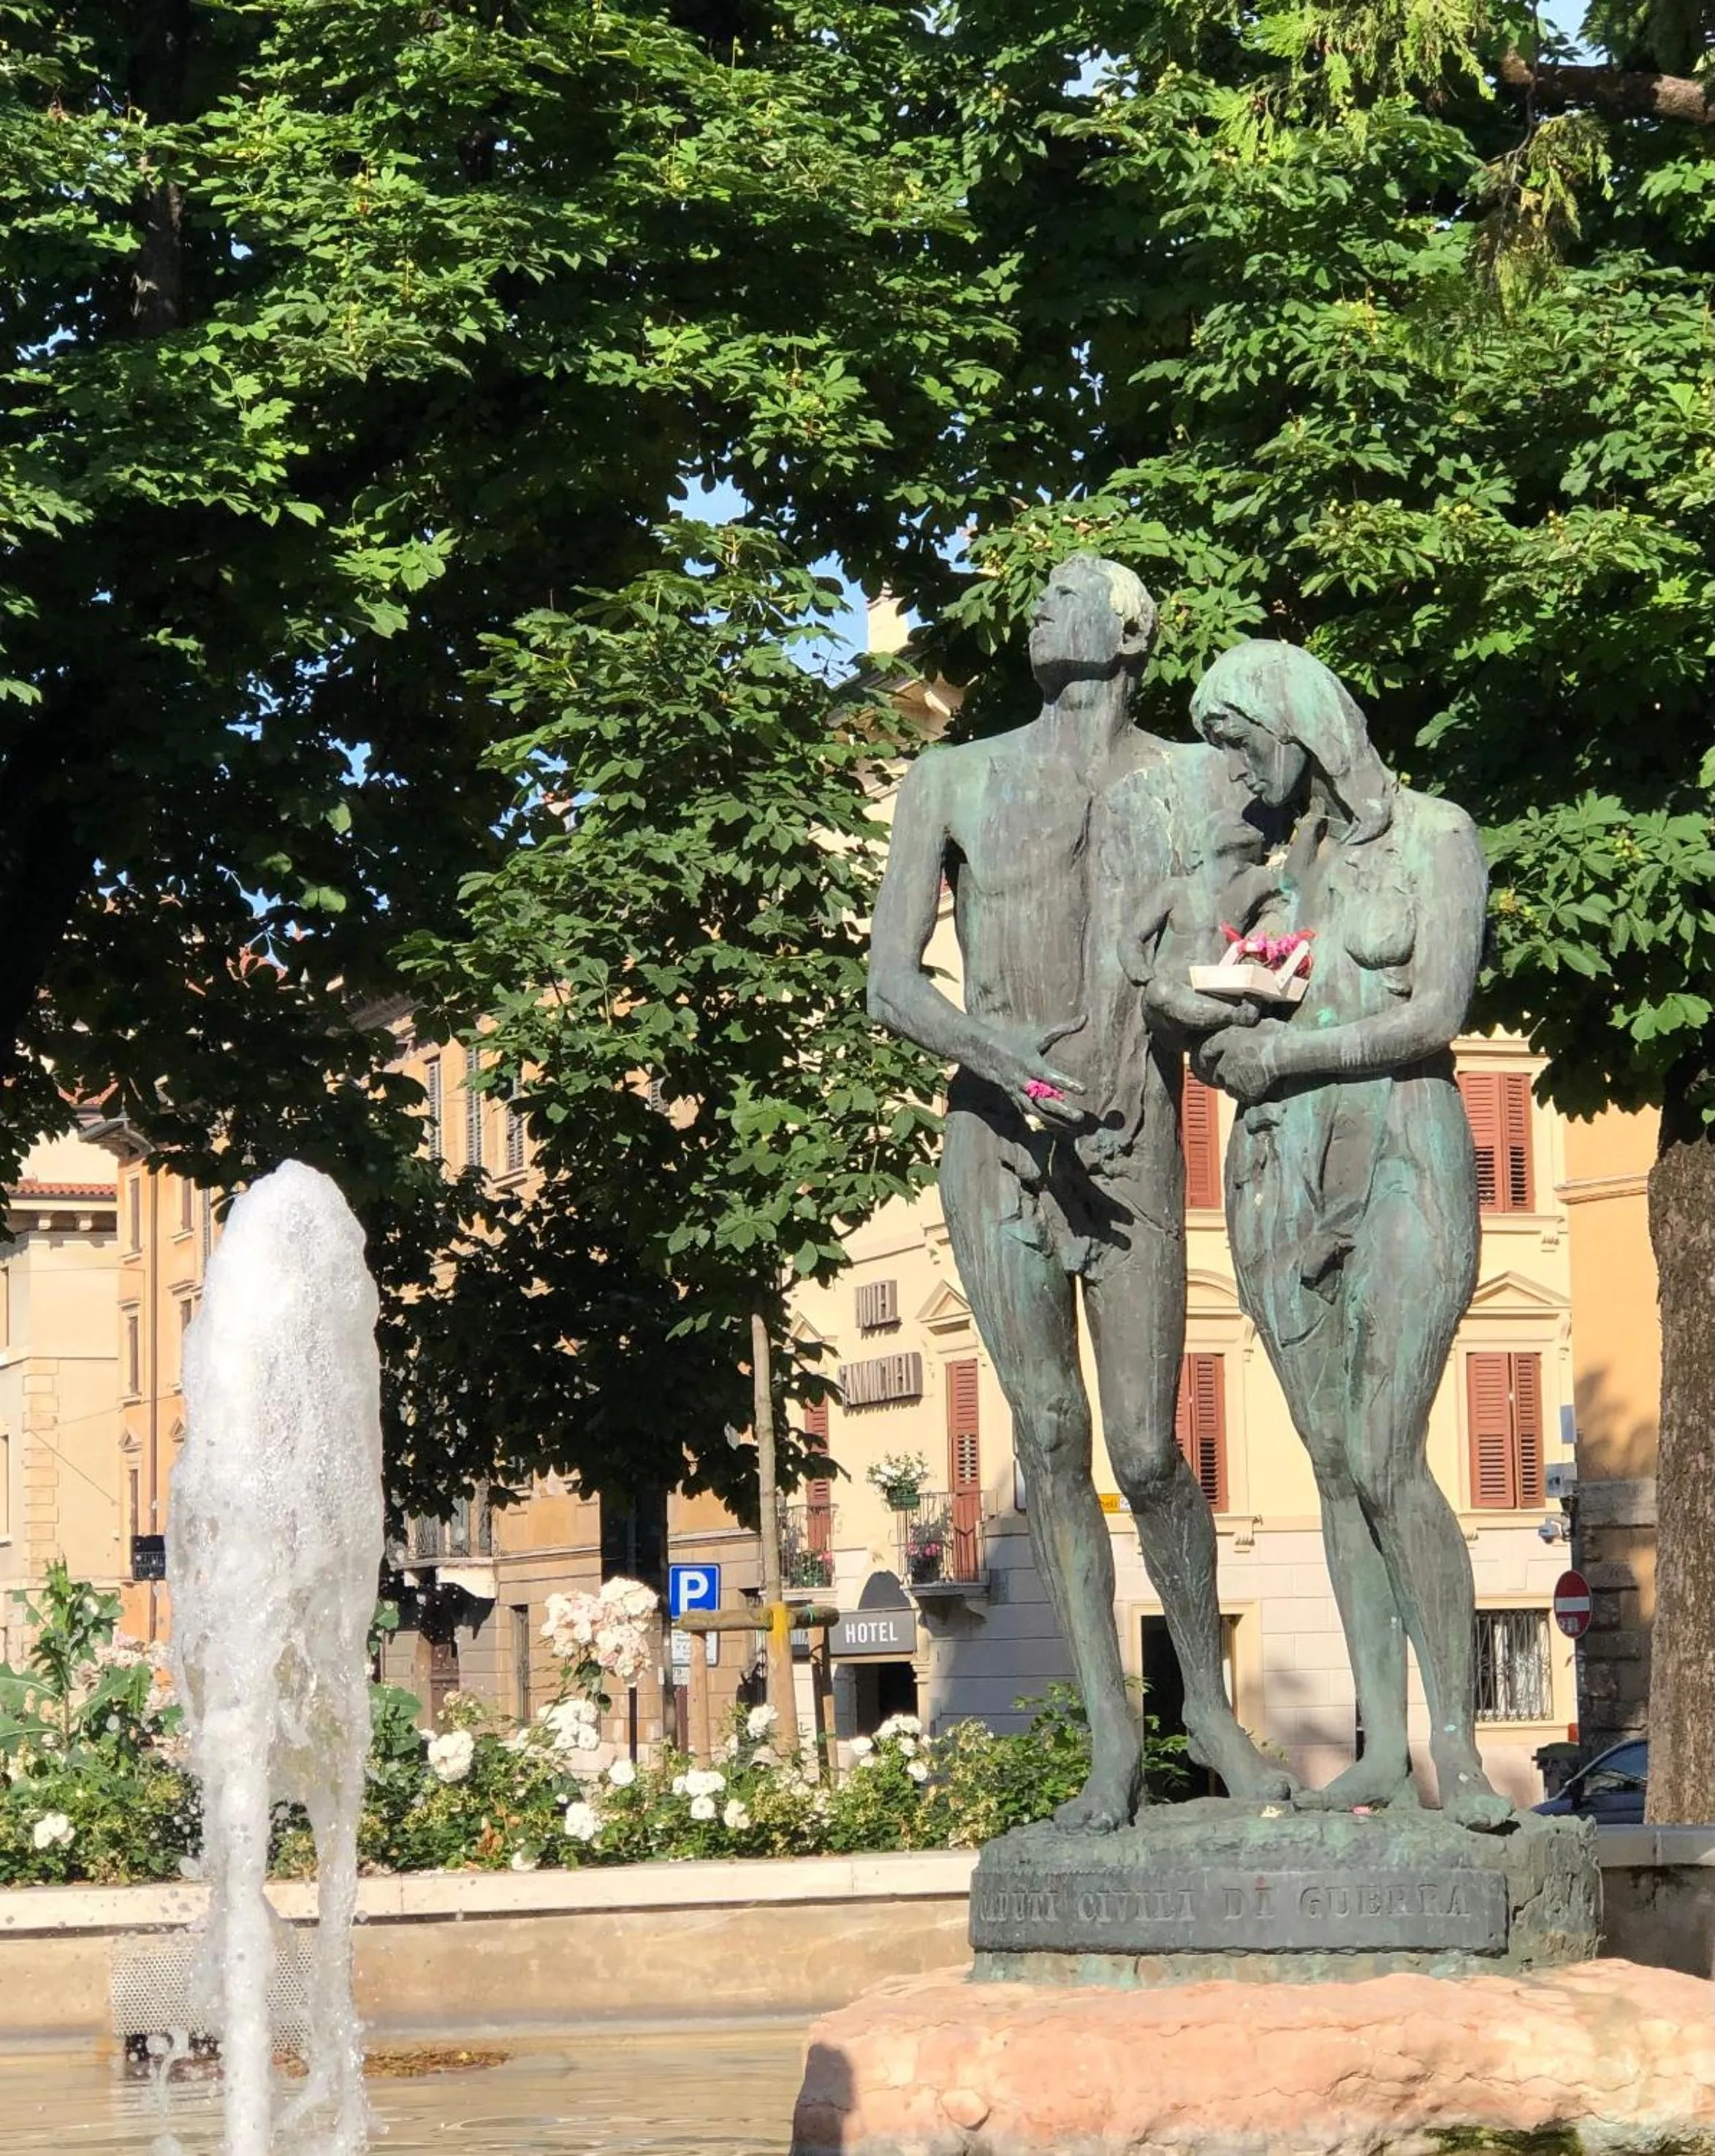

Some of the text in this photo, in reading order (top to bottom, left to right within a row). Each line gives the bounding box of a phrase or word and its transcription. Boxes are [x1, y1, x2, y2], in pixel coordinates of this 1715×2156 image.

[854, 1280, 899, 1327] HOTEL
[680, 1572, 709, 1612] P
[845, 1621, 898, 1644] HOTEL
[1077, 1889, 1197, 1923] CIVILI
[1222, 1887, 1274, 1920] DI
[1300, 1883, 1472, 1919] GUERRA
